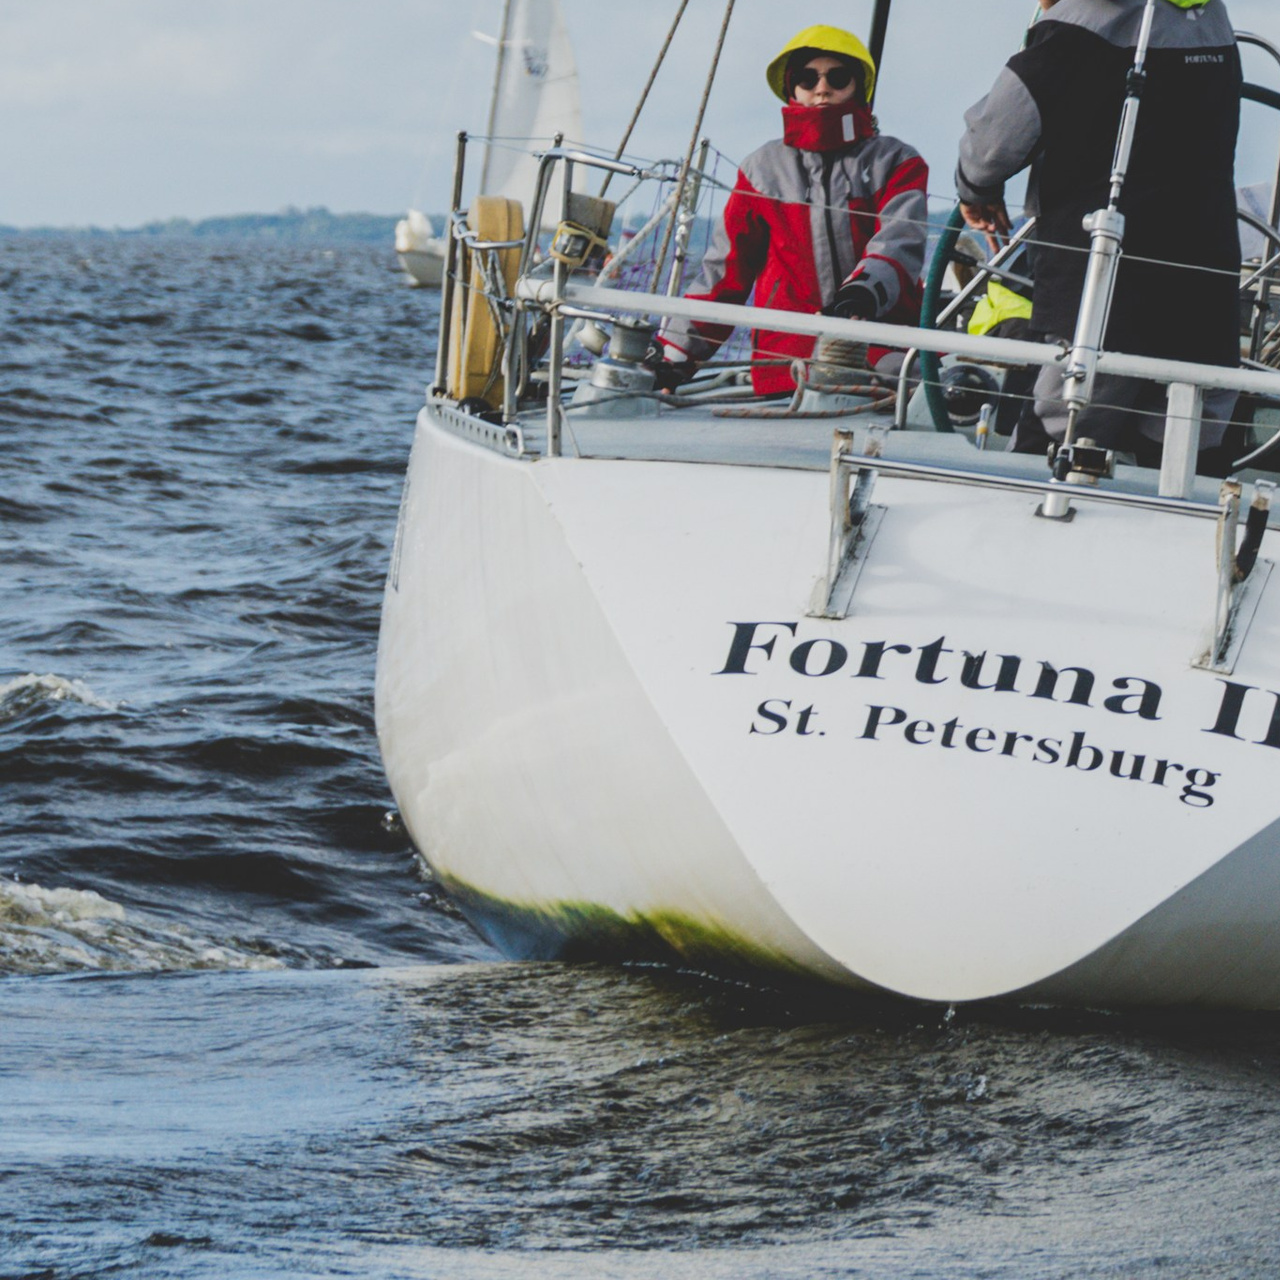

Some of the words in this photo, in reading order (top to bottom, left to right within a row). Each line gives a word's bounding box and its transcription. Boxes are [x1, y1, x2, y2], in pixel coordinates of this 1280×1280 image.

[711, 621, 1164, 721] Fortuna
[748, 699, 826, 736] St.
[857, 704, 1221, 808] Petersburg
